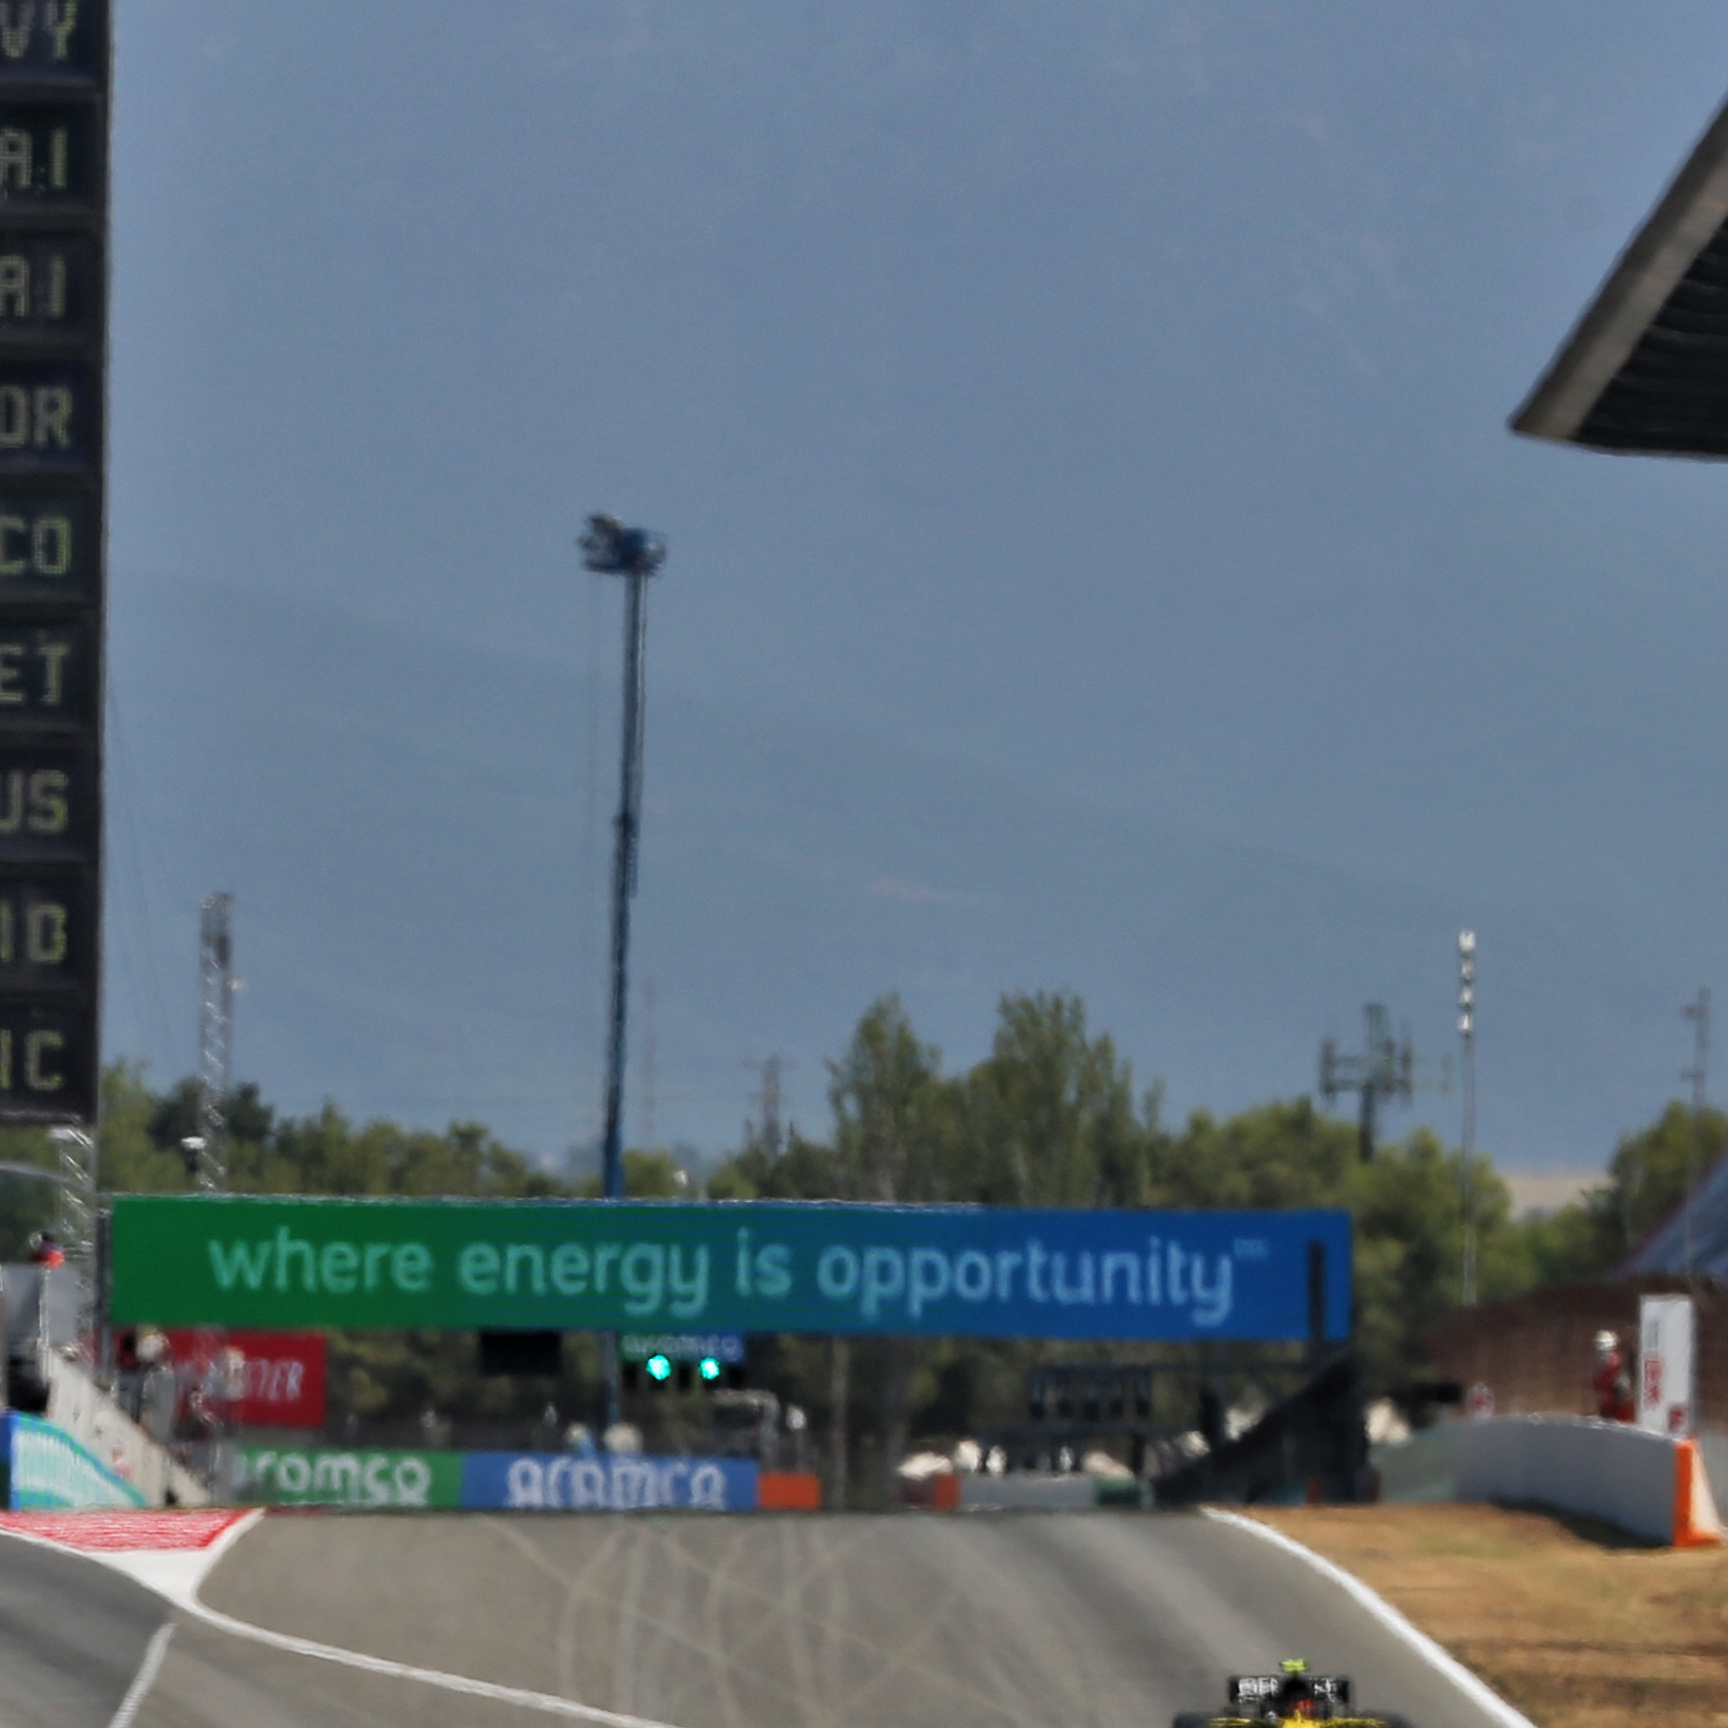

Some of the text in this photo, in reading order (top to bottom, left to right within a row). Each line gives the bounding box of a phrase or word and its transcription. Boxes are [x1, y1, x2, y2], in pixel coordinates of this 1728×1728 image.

[208, 1224, 432, 1292] where
[456, 1240, 711, 1319] energy
[734, 1226, 793, 1297] is
